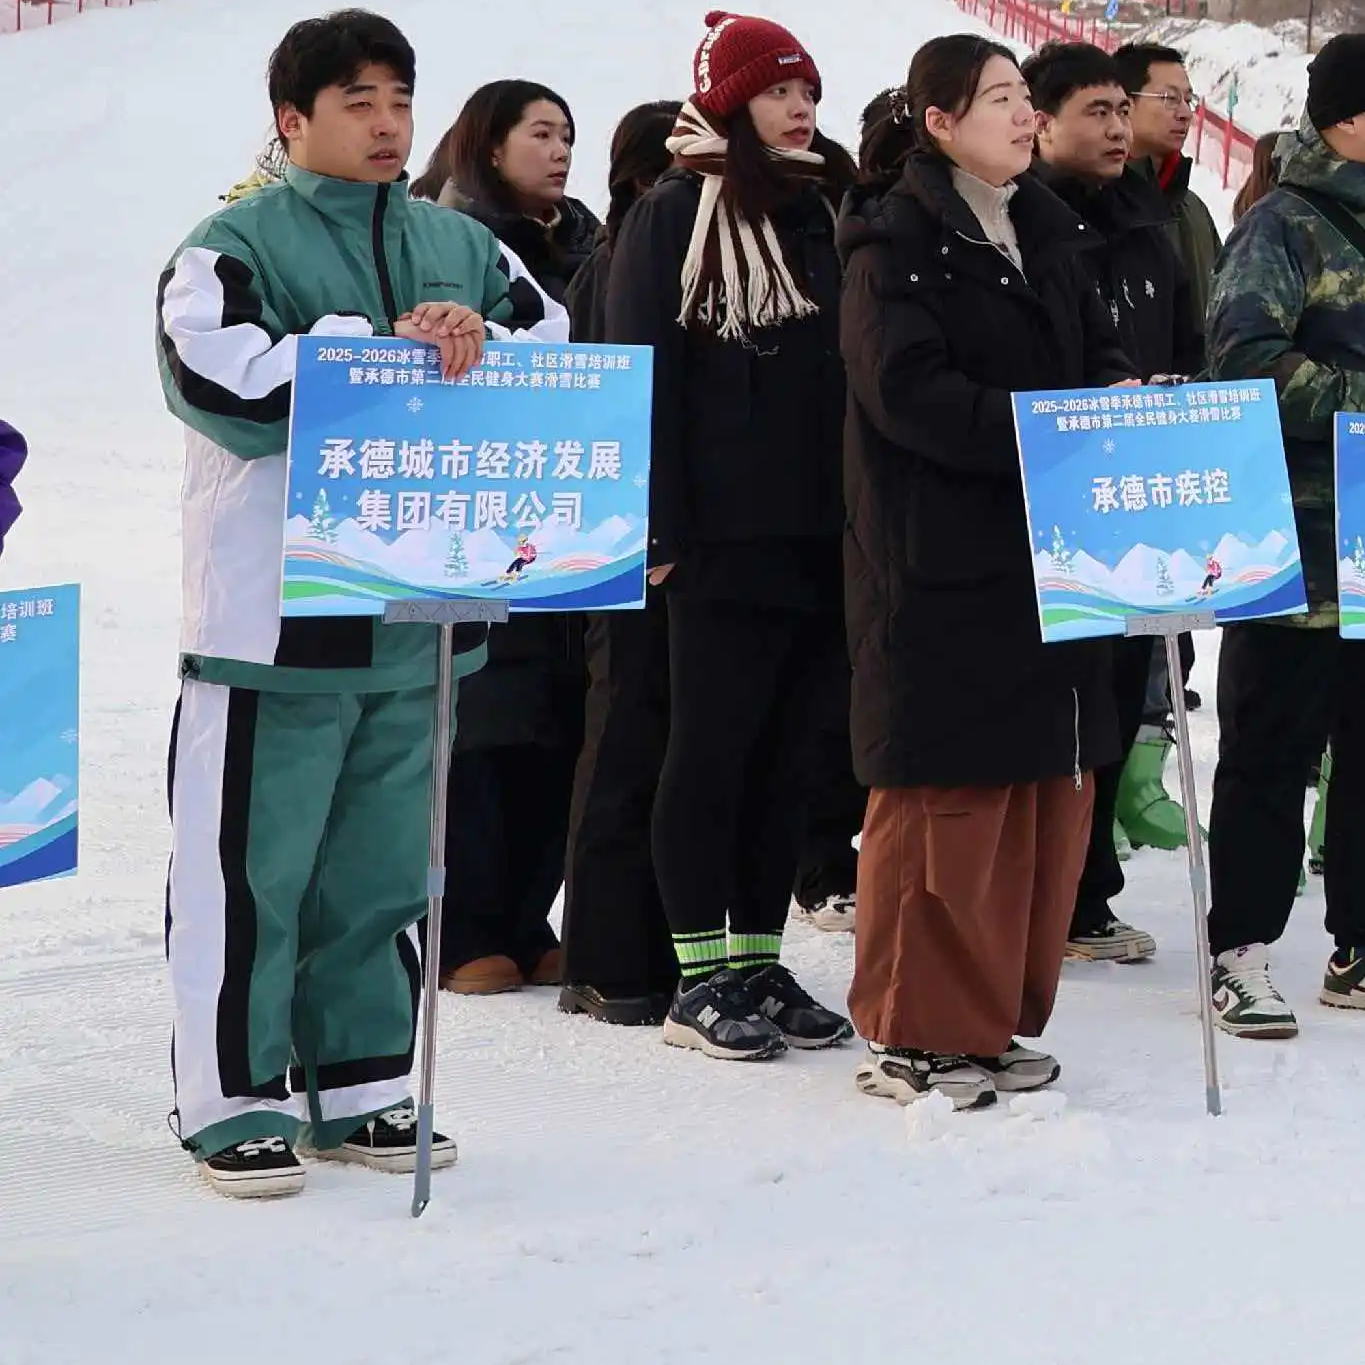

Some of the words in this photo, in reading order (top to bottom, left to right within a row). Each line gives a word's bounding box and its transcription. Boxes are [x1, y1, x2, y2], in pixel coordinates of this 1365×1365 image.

[317, 346, 631, 371] 2025-2026冰雪季职工、社区滑雪培训班
[317, 438, 623, 481] 承德城市经济发展
[355, 489, 583, 531] 集团有限公司
[1090, 469, 1232, 514] 承德市疾控
